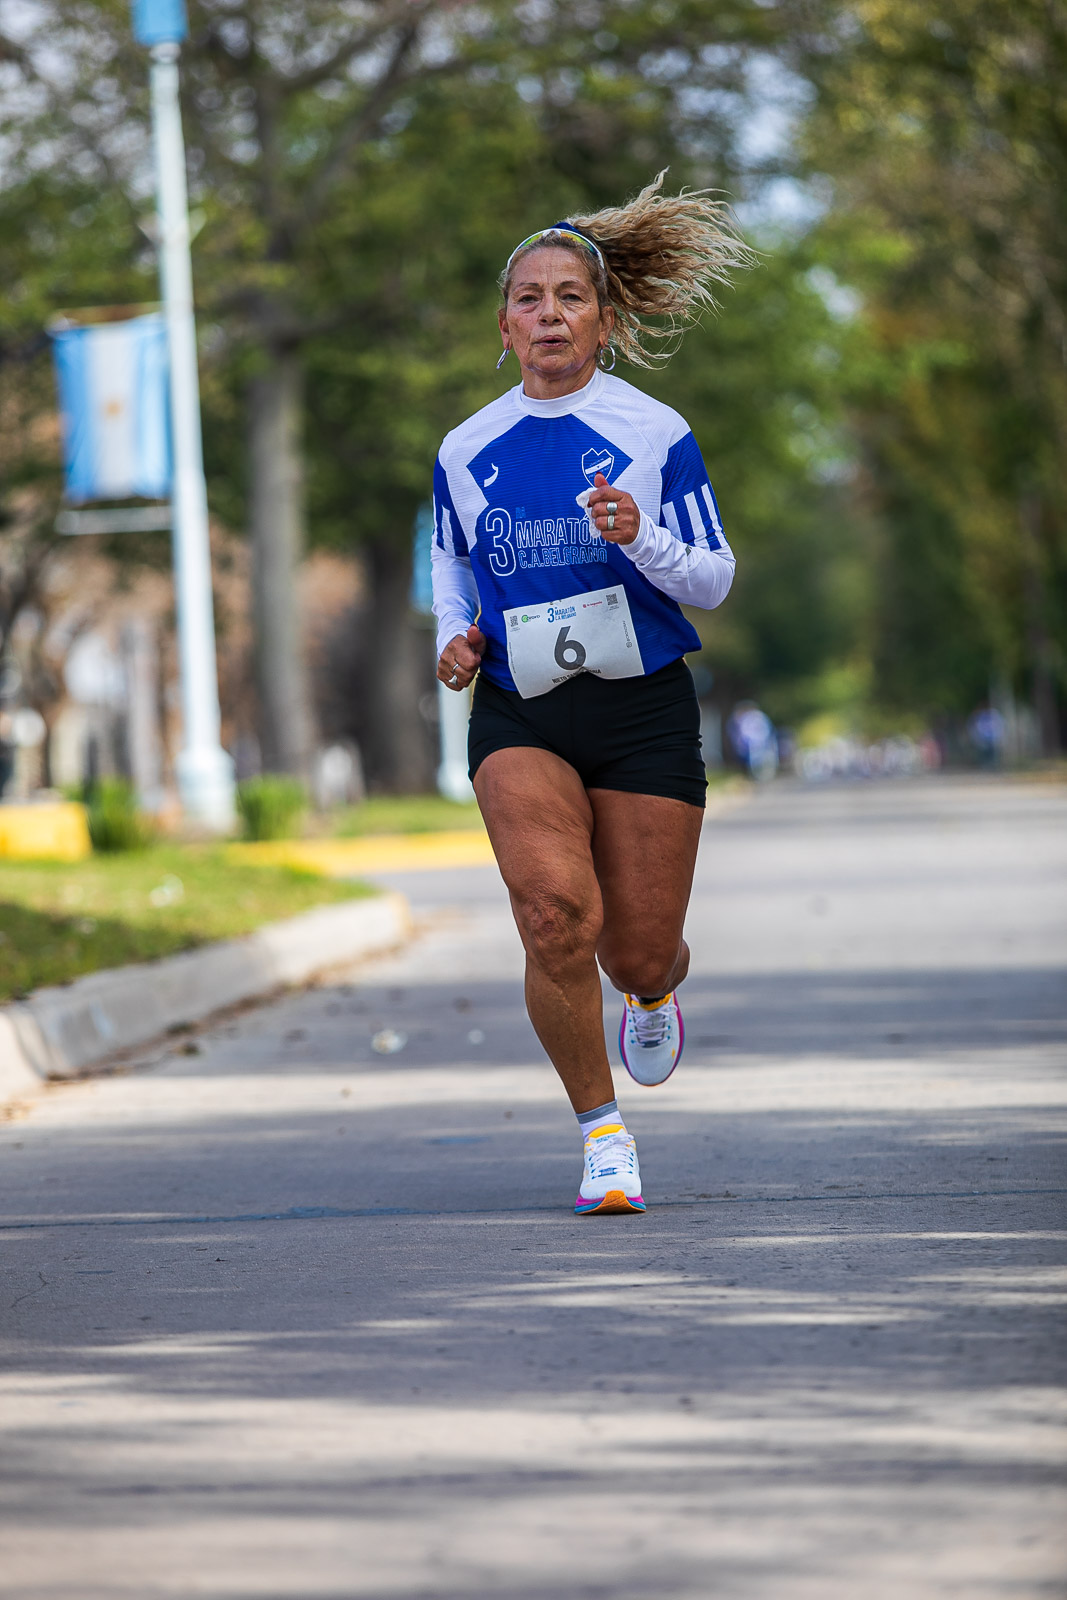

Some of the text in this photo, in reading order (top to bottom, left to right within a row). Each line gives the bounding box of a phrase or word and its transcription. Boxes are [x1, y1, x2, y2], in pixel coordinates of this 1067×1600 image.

[485, 507, 517, 577] 3
[547, 607, 555, 622] 3
[555, 606, 576, 616] MARATÓN
[554, 625, 587, 671] 6
